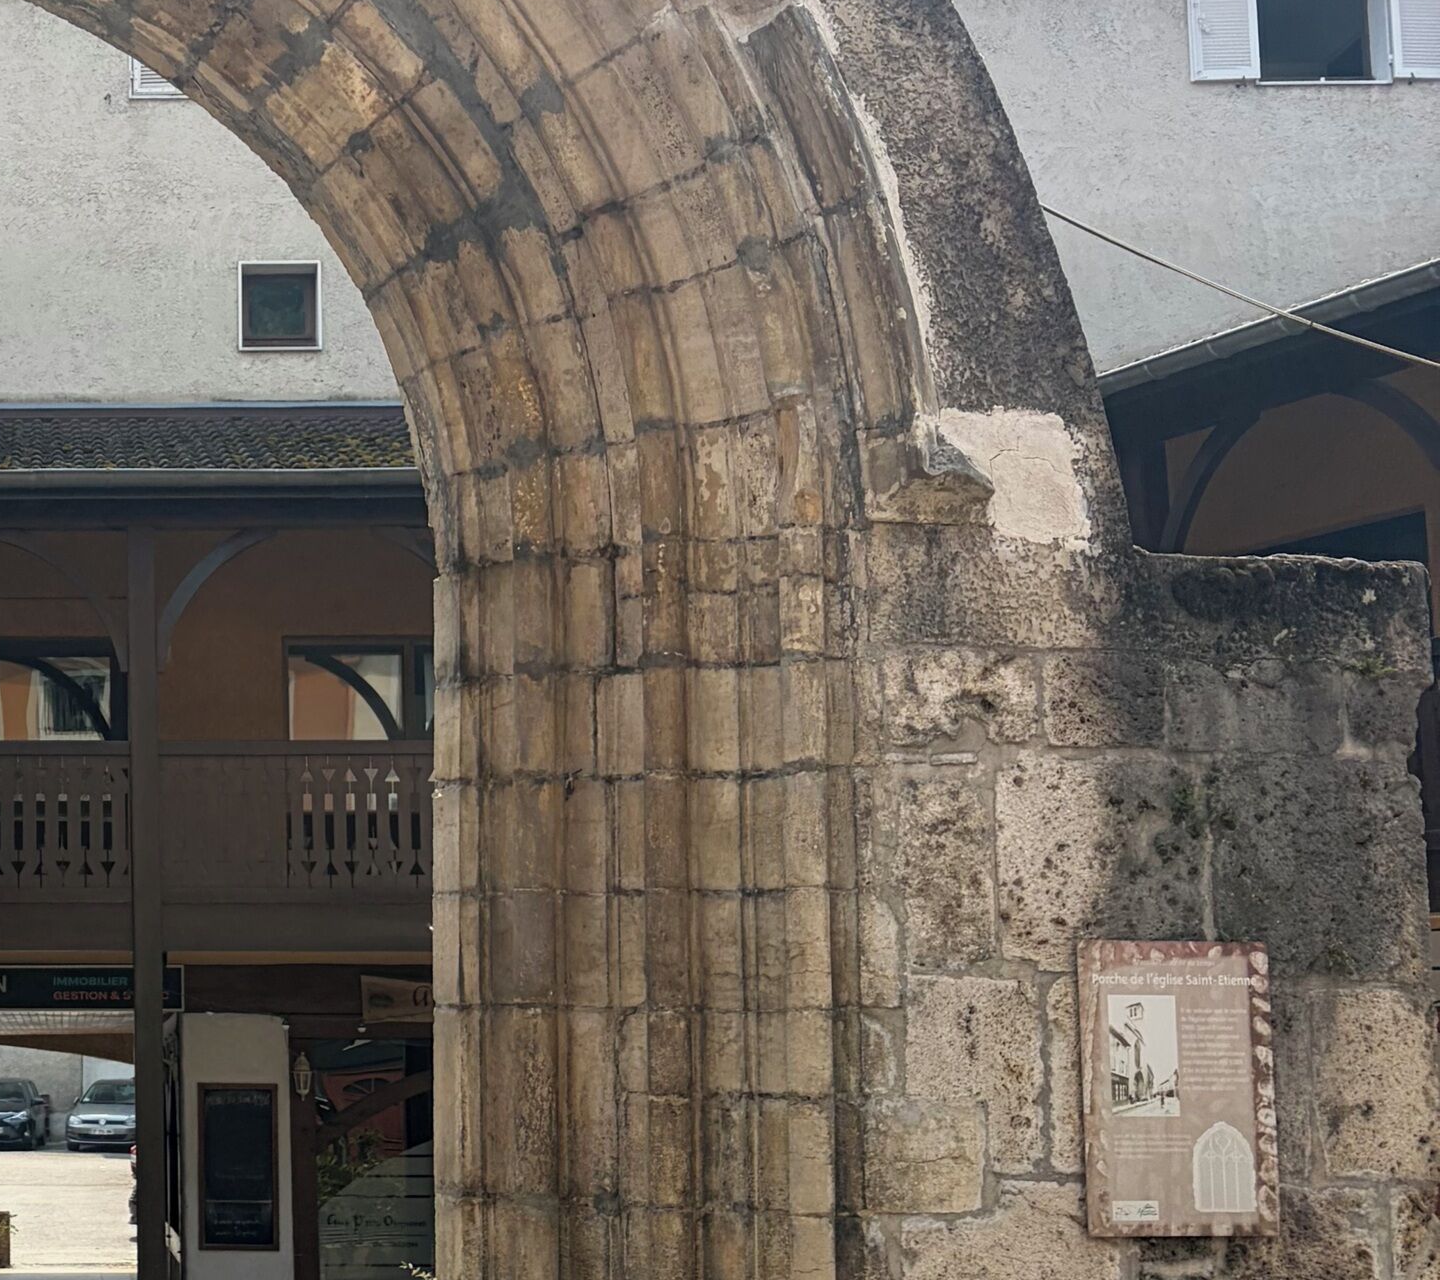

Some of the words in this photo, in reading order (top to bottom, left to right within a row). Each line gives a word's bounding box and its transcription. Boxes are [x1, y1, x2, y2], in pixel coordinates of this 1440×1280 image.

[52, 976, 128, 986] IMMOBILIER
[1092, 974, 1128, 985] Porche
[1130, 974, 1144, 985] de
[1146, 974, 1184, 989] l'église
[1185, 974, 1257, 986] Saint-Etienne
[52, 990, 108, 1000] GESTION
[110, 991, 120, 1000] &
